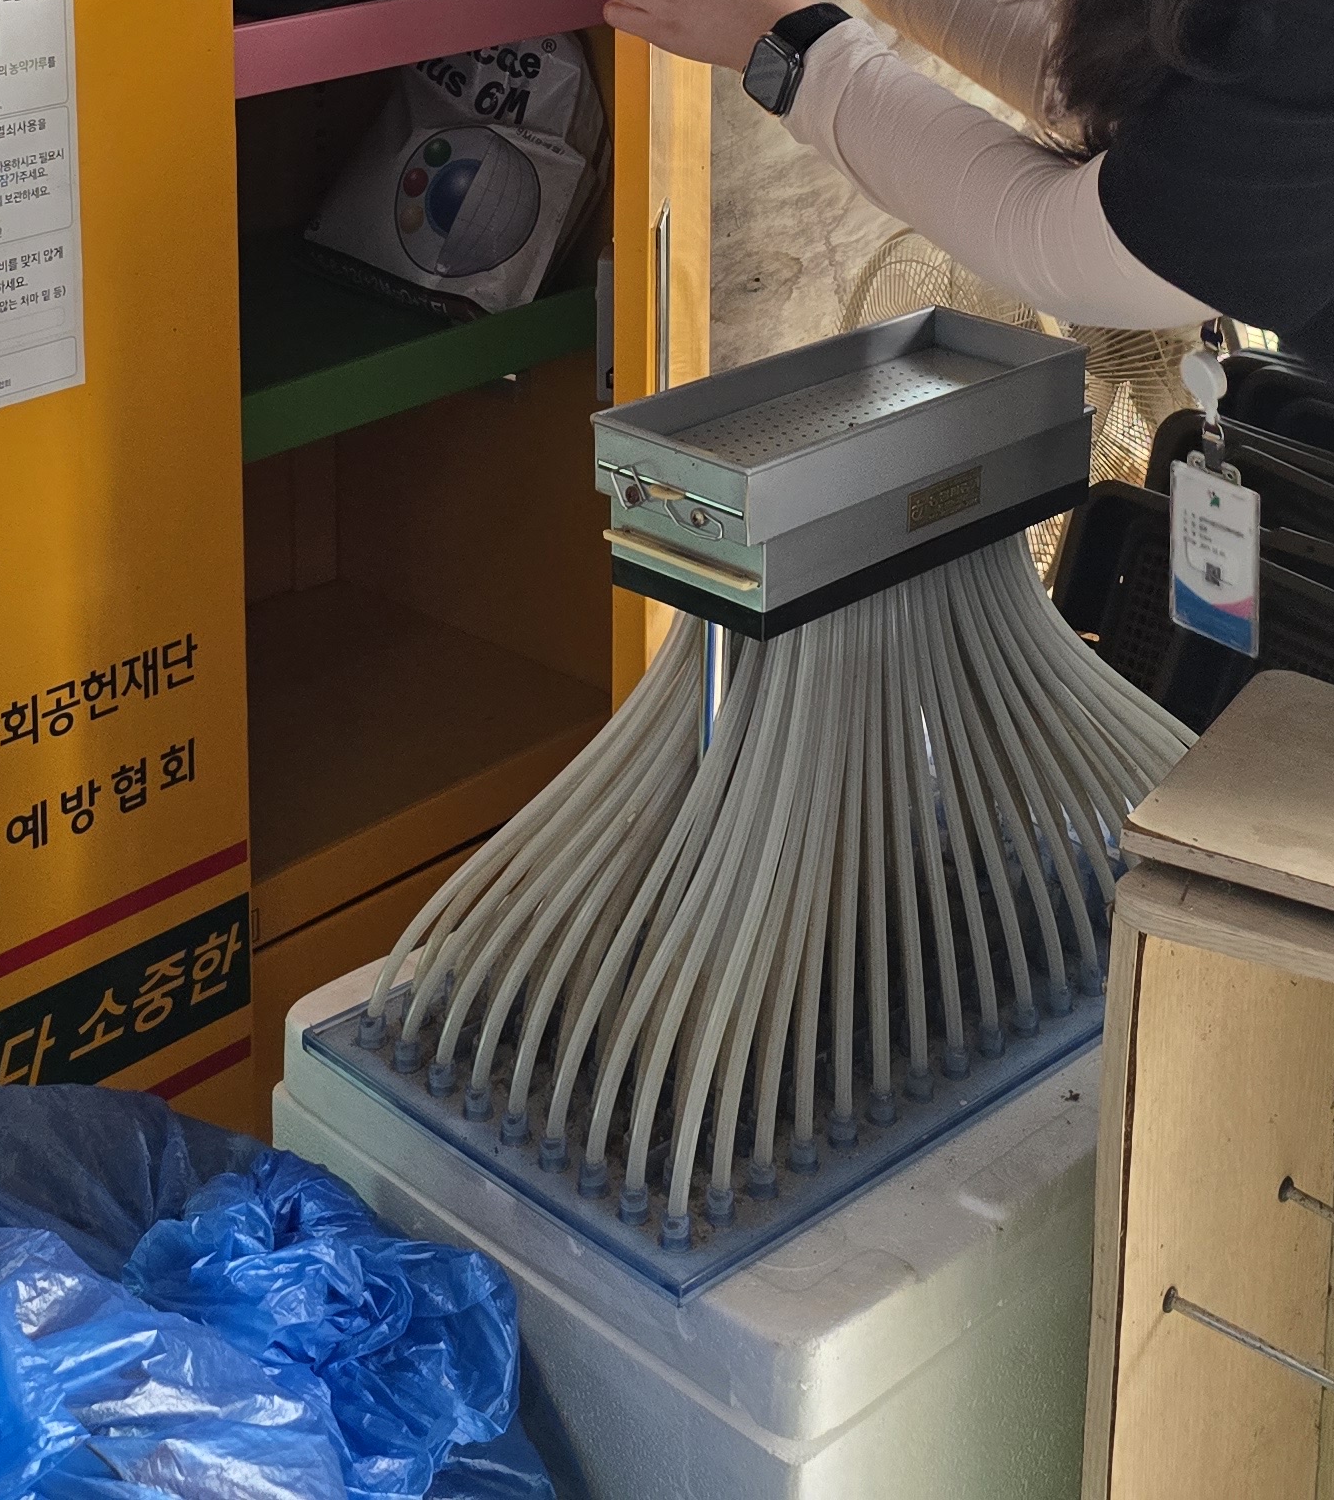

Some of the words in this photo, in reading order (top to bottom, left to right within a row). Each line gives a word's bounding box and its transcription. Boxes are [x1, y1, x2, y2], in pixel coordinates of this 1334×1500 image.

[0, 258, 17, 272] 비를
[21, 252, 41, 268] 맞지
[44, 246, 64, 262] 않게
[0, 298, 17, 312] 않는
[69, 922, 242, 1060] 소중한
